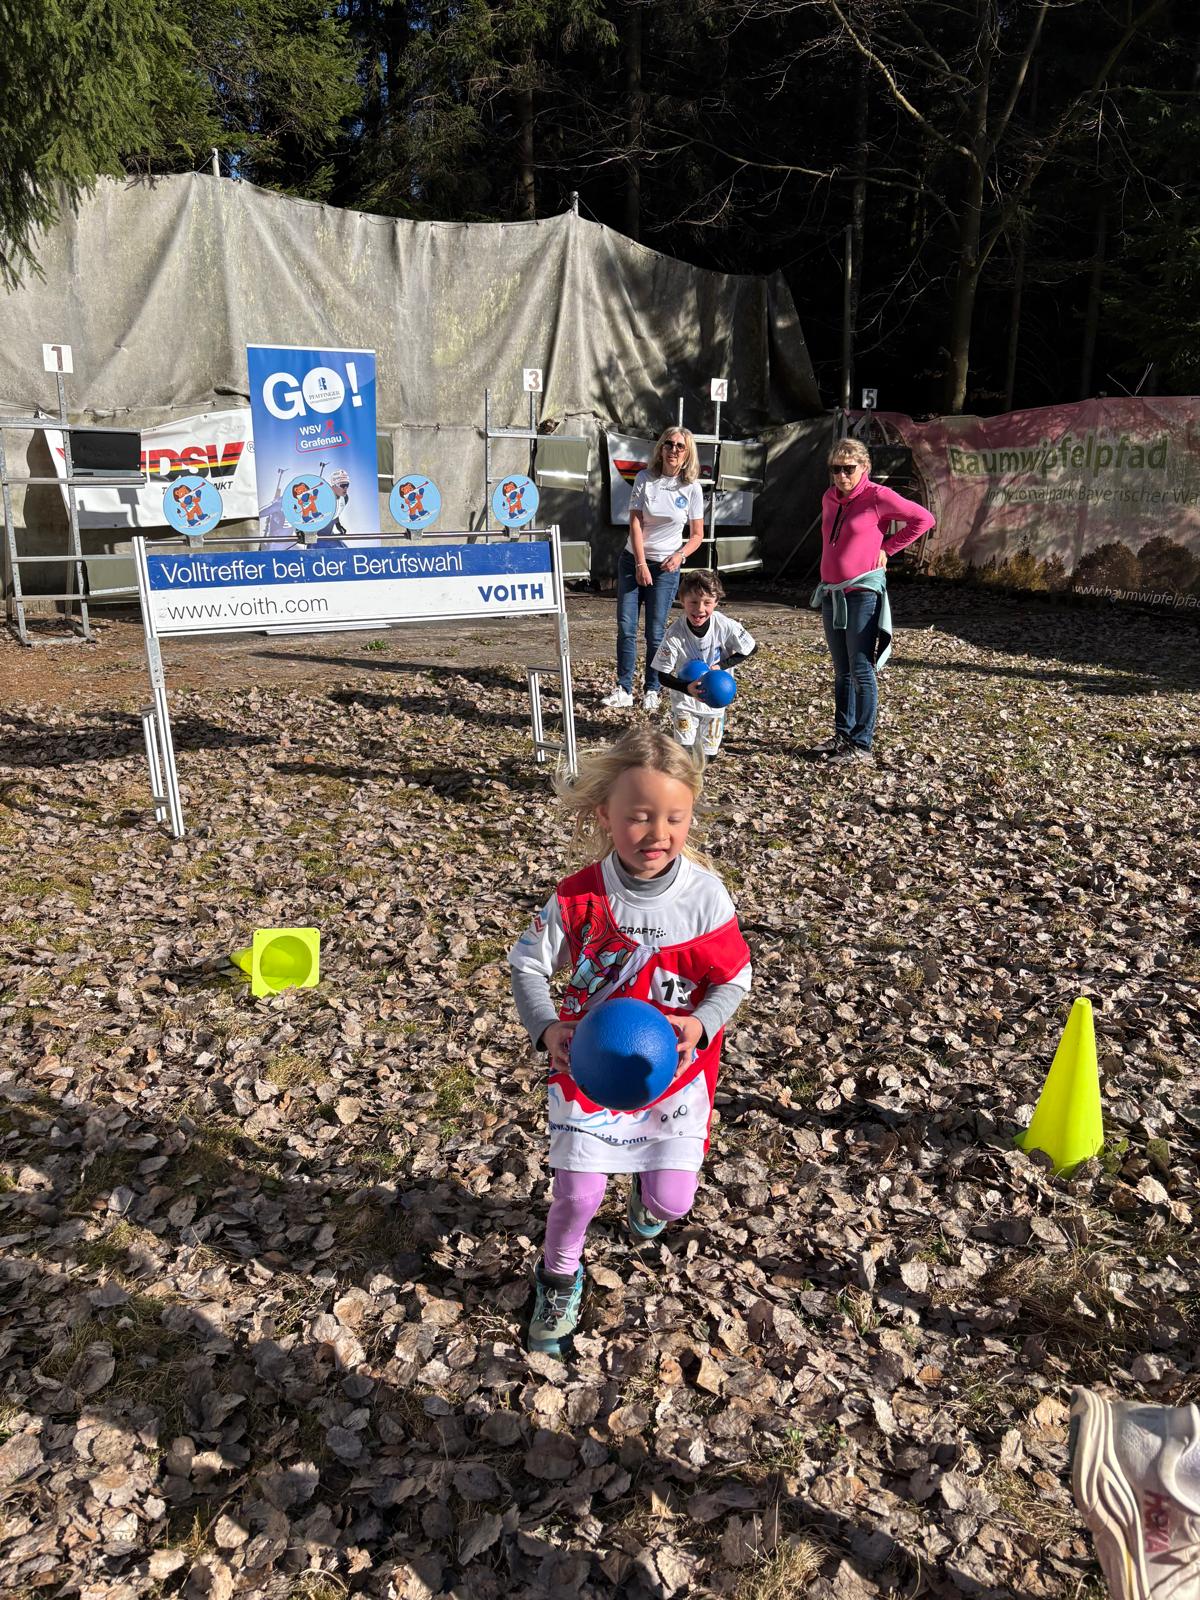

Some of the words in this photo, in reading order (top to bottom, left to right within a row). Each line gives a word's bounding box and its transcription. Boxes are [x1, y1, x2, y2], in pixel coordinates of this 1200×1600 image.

[51, 345, 64, 372] 1
[528, 370, 540, 390] 3
[262, 362, 363, 420] GO!
[714, 382, 726, 401] 4
[865, 389, 875, 408] 5
[299, 424, 322, 436] WSV
[300, 435, 343, 449] Grafenau
[149, 441, 245, 483] DSV
[951, 436, 1167, 478] Baumwipfelpfad
[1078, 485, 1169, 505] Bayerischer
[160, 559, 266, 584] Volltreffer
[272, 557, 306, 579] bei
[312, 556, 347, 577] der
[353, 551, 463, 575] Berufswahl
[477, 583, 544, 602] VOITH
[167, 597, 329, 620] www.voith.com
[616, 925, 657, 936] CRAFT
